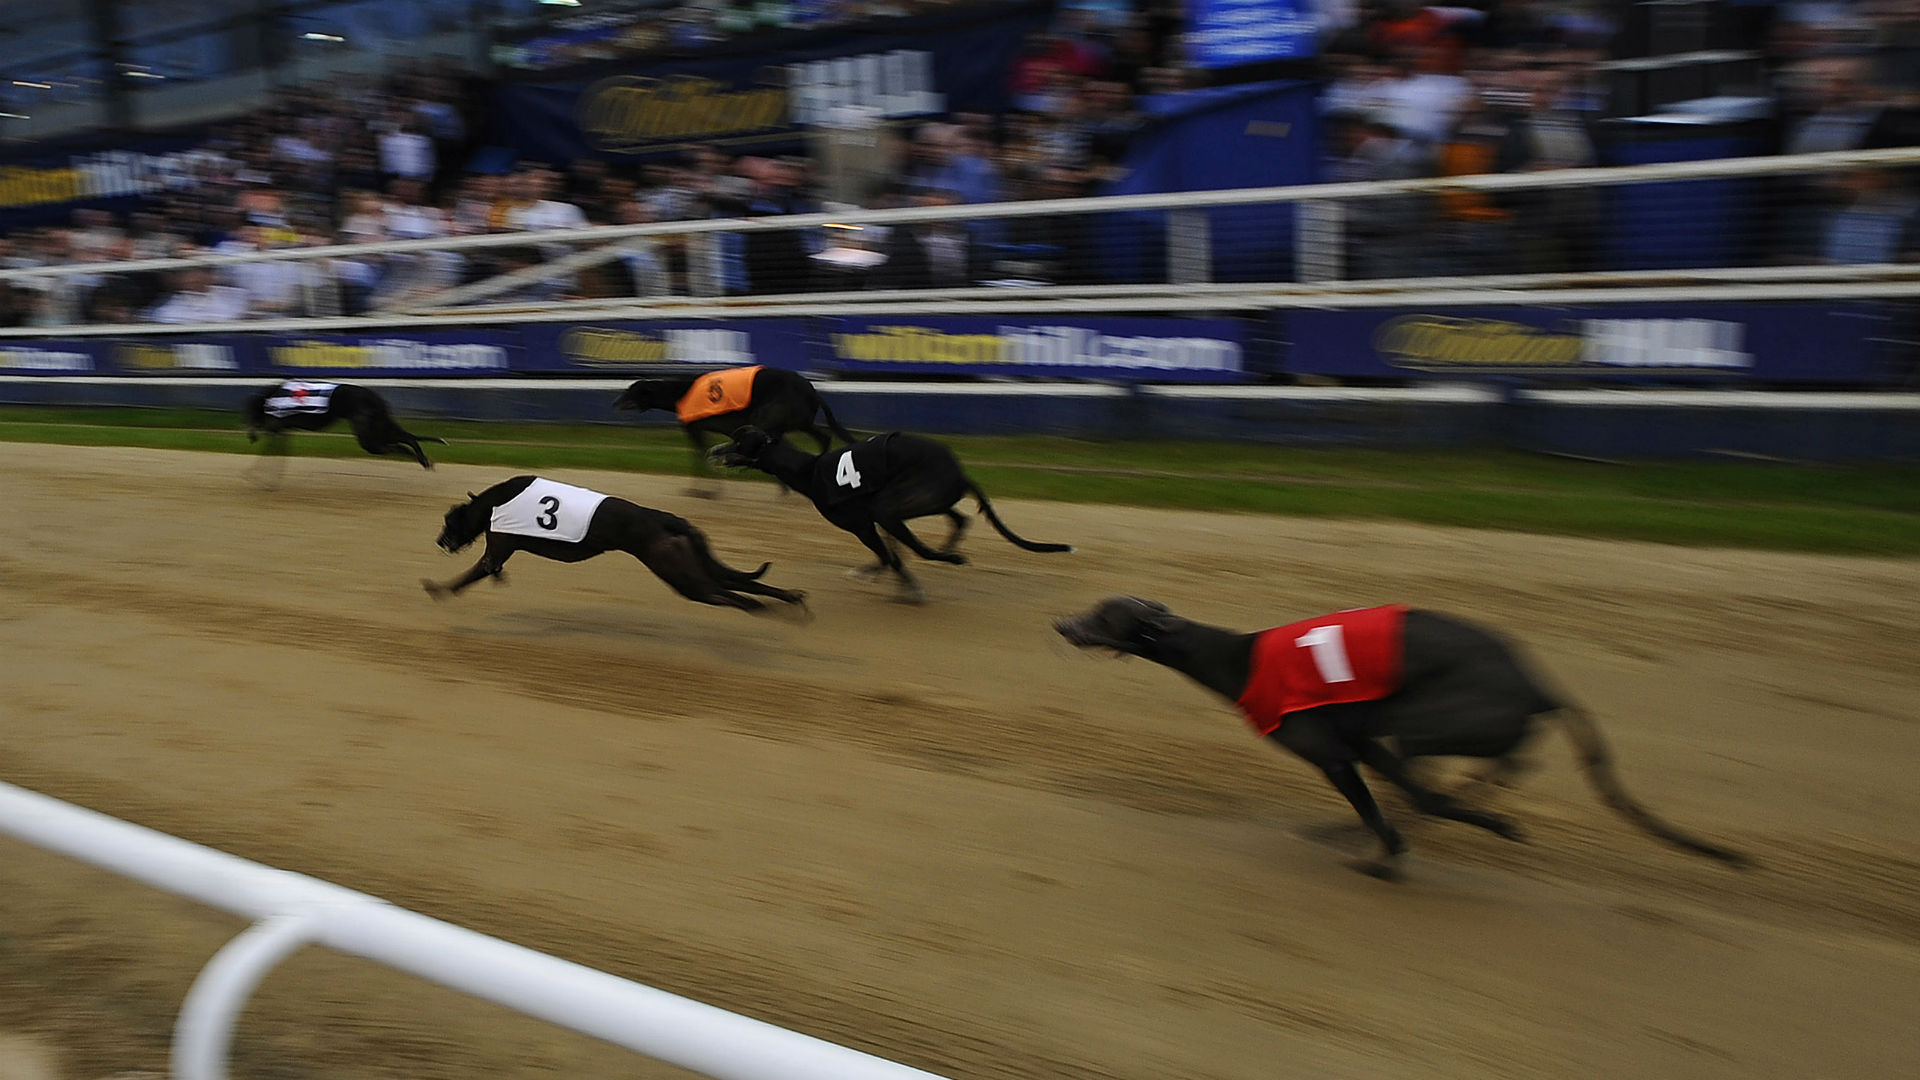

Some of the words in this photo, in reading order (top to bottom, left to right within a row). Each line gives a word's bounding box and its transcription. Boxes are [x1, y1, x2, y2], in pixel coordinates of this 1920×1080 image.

[708, 378, 724, 403] 5
[834, 450, 862, 489] 4
[536, 495, 560, 531] 3
[1294, 624, 1357, 684] 1
